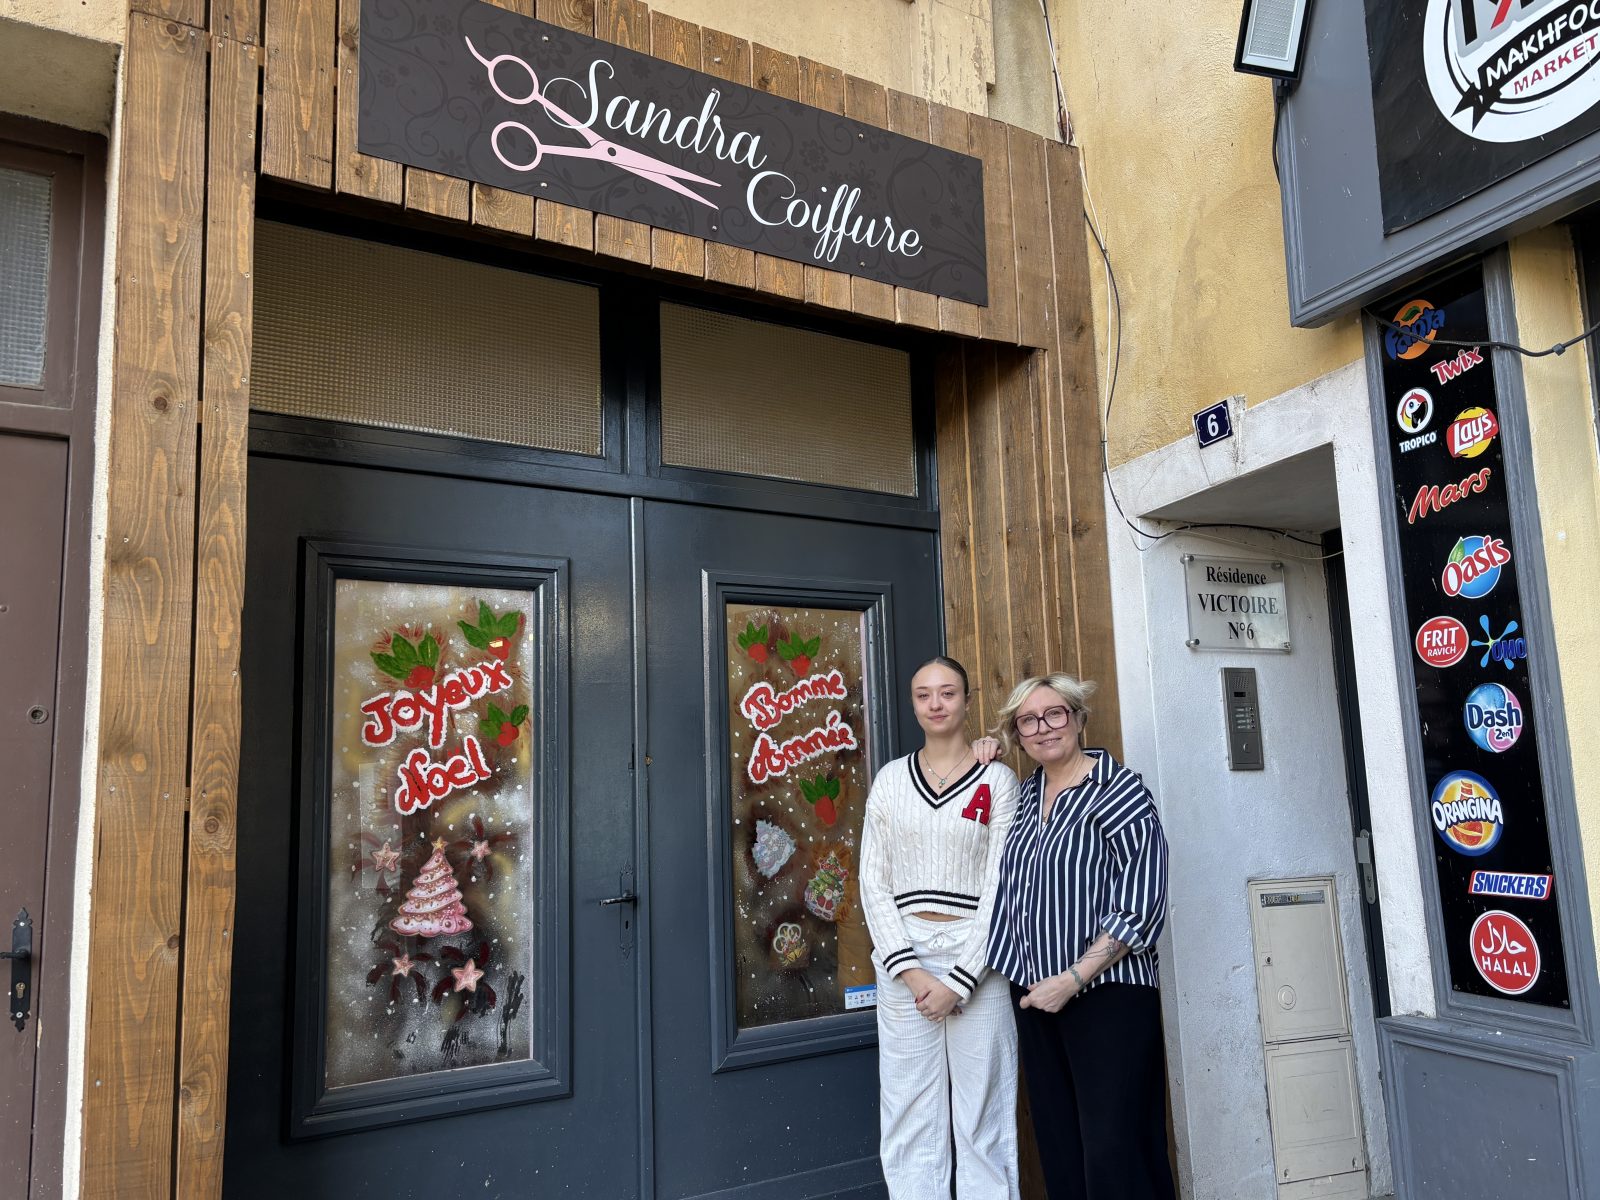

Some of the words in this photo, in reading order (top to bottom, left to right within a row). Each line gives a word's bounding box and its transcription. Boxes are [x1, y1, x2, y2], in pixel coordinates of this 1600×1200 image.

[1514, 33, 1598, 95] MARKET
[543, 60, 767, 169] Sandra
[746, 171, 923, 262] Coiffure
[1385, 308, 1445, 361] Fanta
[1430, 345, 1484, 386] Twix
[1207, 413, 1219, 437] 6
[1454, 413, 1493, 455] Lay's
[1399, 432, 1437, 453] TROPICO
[1408, 467, 1492, 525] Mars
[1206, 566, 1267, 585] Résidence
[1442, 535, 1511, 596] Oasis
[1198, 593, 1279, 615] VICTOIRE
[1423, 626, 1460, 648] FRIT
[1427, 646, 1457, 657] RAVICH
[1491, 638, 1527, 661] OMO
[1467, 702, 1522, 729] Dash
[961, 784, 991, 825] A
[1432, 797, 1504, 832] ORANGINA
[1473, 872, 1547, 898] SNICKERS
[1481, 920, 1527, 954] حلال
[1482, 956, 1531, 977] HALAL
